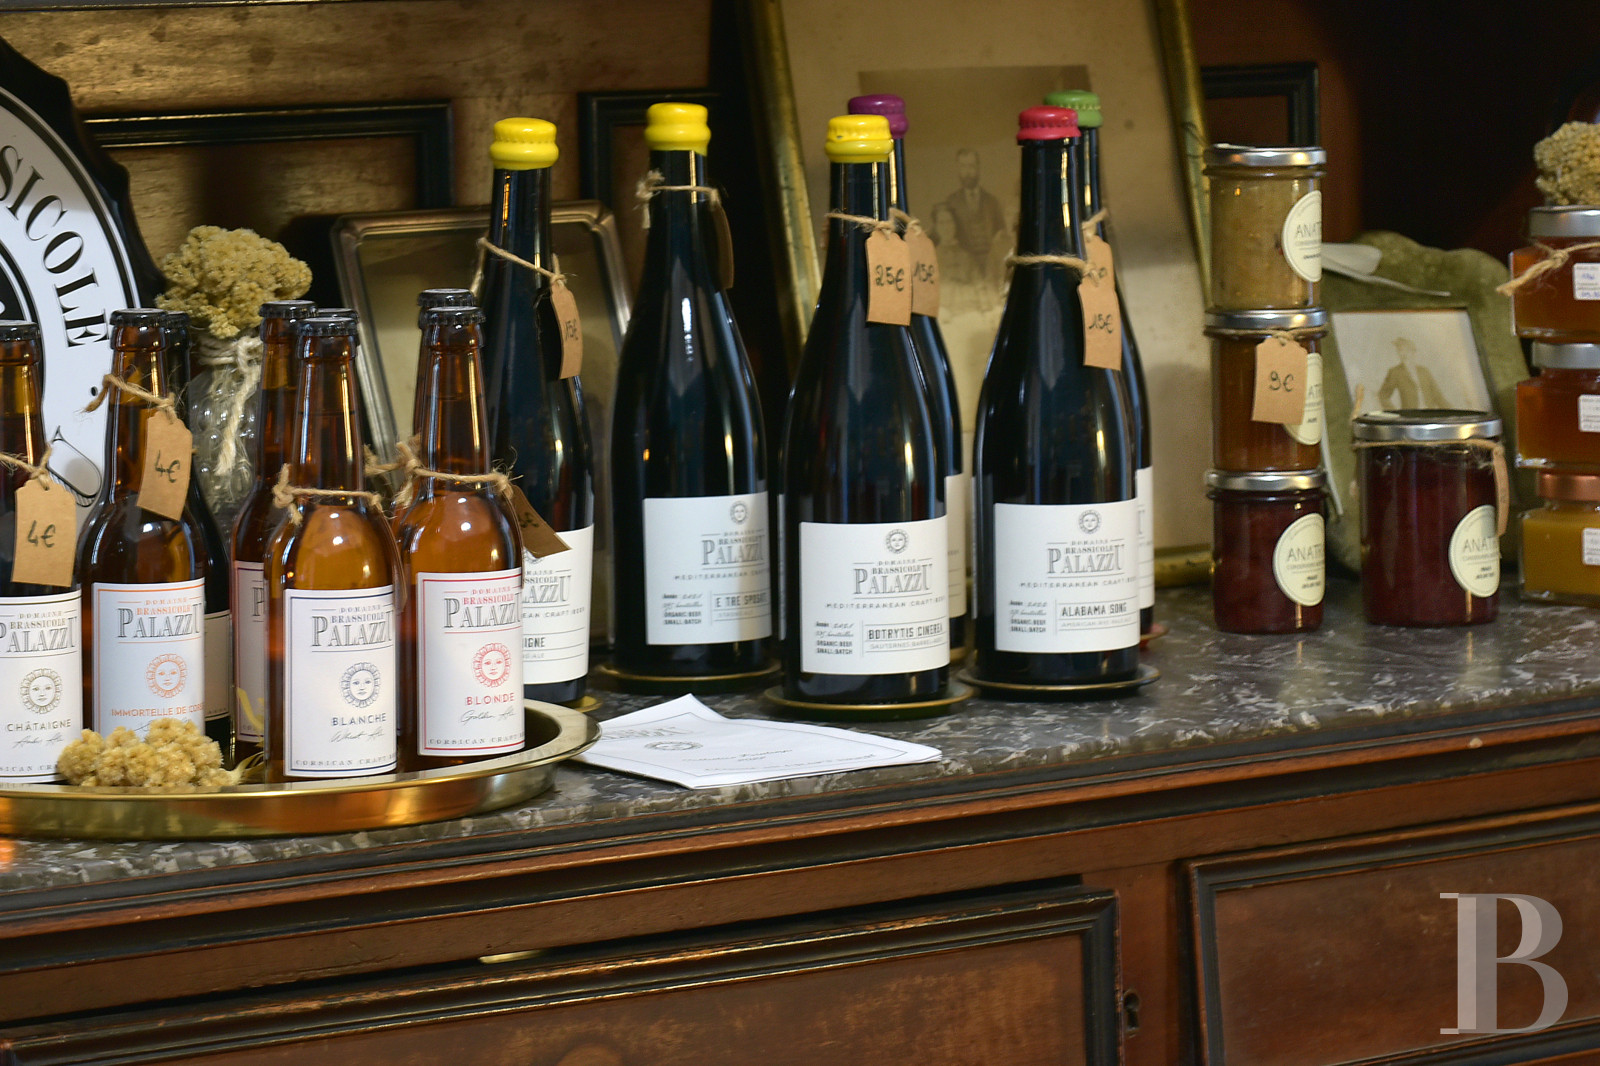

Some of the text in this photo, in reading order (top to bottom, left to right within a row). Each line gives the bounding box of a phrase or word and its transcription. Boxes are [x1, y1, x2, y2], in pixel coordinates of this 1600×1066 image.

[875, 264, 905, 292] 25€
[1088, 313, 1113, 334] 15€
[155, 450, 181, 483] 4€
[27, 520, 56, 548] 4€
[1065, 545, 1113, 555] BRASSICOLE
[872, 565, 921, 575] BRASSICOLE
[472, 586, 511, 595] DOMAINE
[1020, 581, 1098, 589] MEDITERRANEAN
[145, 597, 188, 605] DOMAINE
[463, 593, 514, 605] BRASSICOLE
[716, 597, 721, 608] E
[826, 602, 906, 610] MEDITERRANEAN
[910, 598, 933, 607] CRAFT
[136, 604, 191, 616] BRASSICOLE
[340, 604, 381, 613] DOMAINE
[1062, 602, 1127, 617] ALABAMA SONG
[19, 611, 63, 619] DOMAINE
[331, 611, 386, 624] BRASSICOLE
[10, 618, 66, 629] BRASSICOLE
[868, 628, 914, 640] BOTRYTIS
[466, 692, 515, 706] BLONDE
[111, 707, 173, 717] IMMORTELLE
[176, 706, 187, 715] DE
[332, 712, 387, 726] BLANCHE
[6, 719, 72, 732] CHÂTAIGNE
